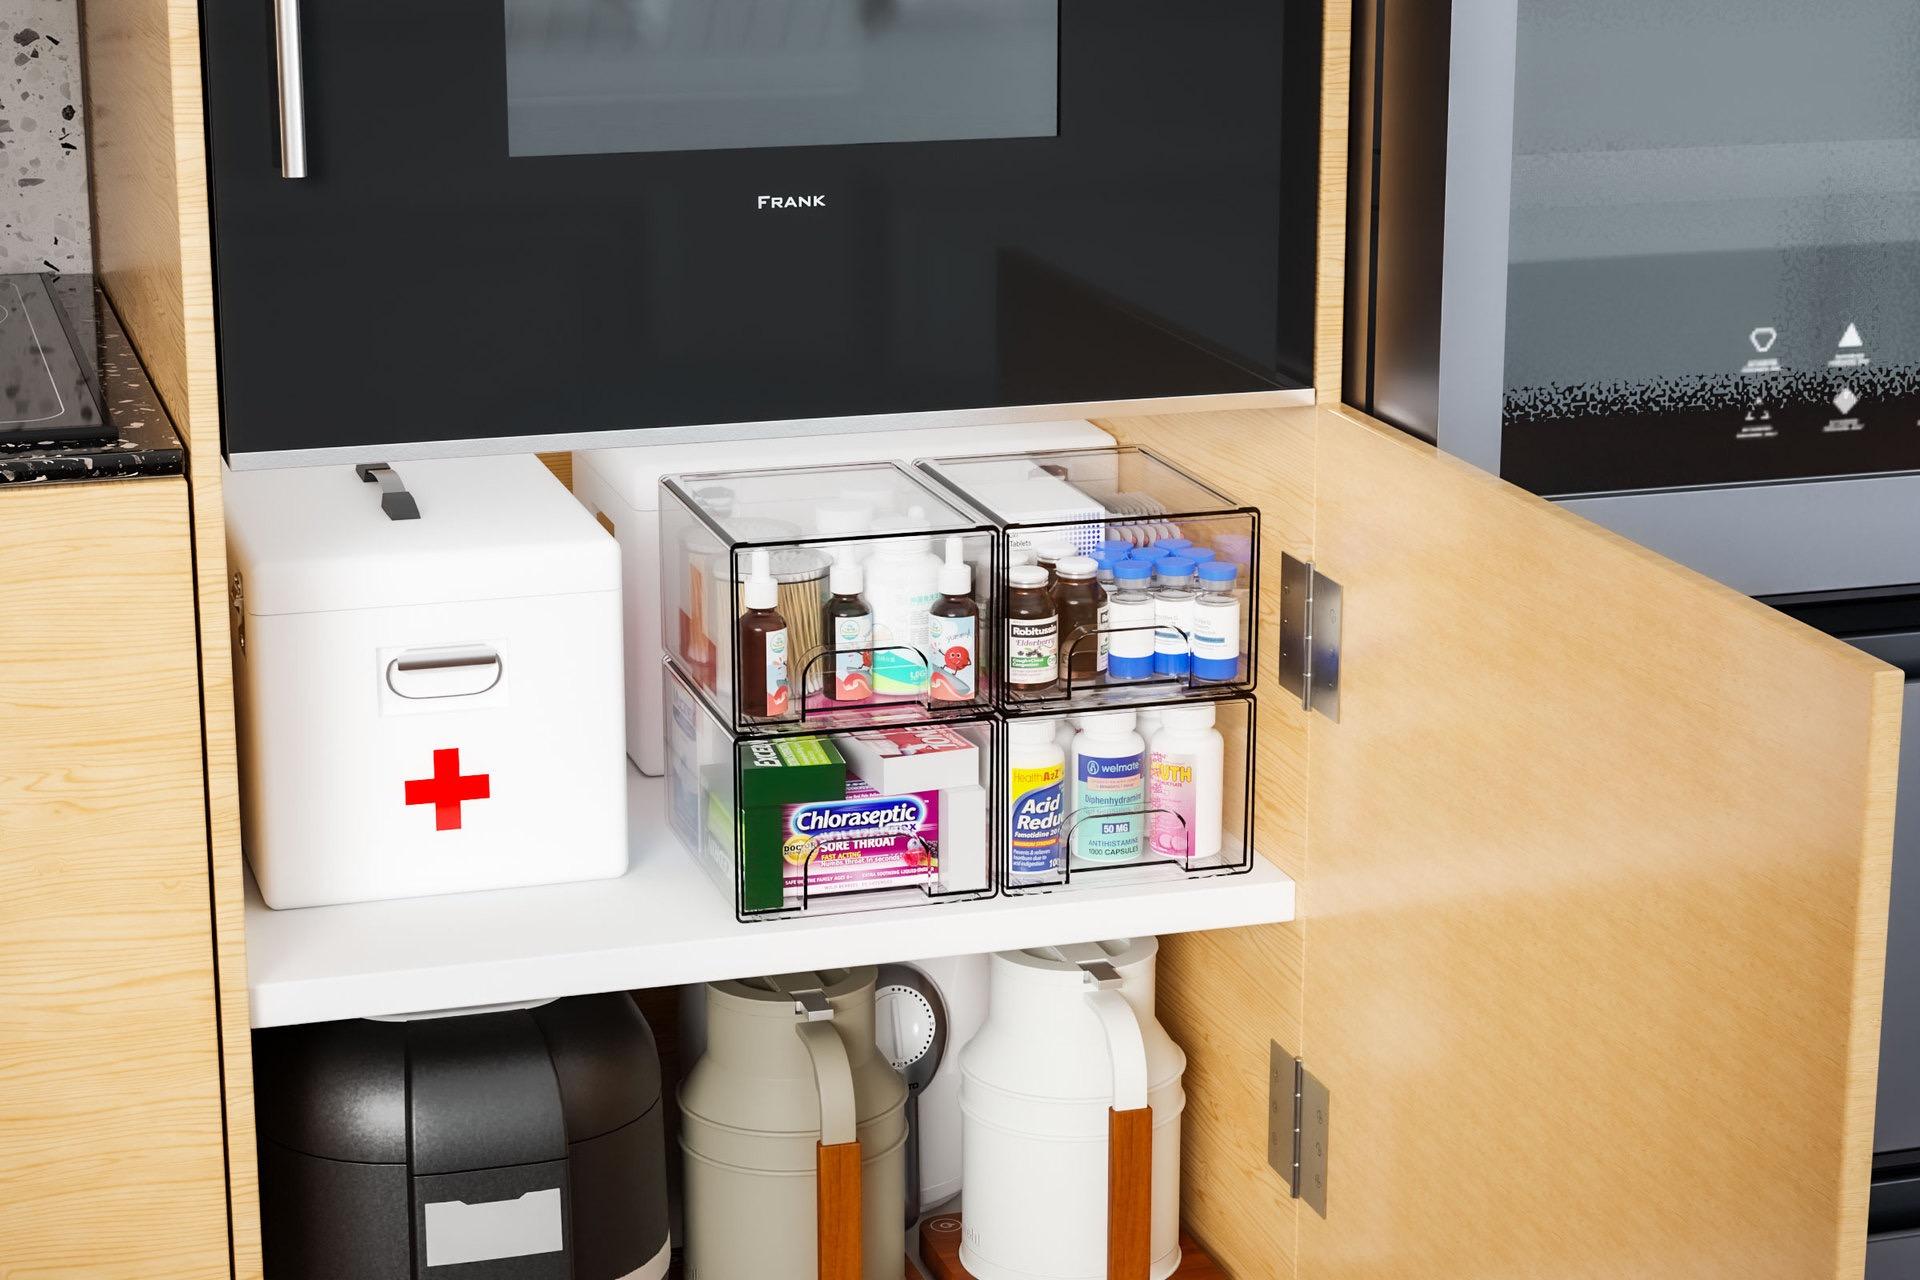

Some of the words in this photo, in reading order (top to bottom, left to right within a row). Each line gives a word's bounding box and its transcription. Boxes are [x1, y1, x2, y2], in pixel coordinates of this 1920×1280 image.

[757, 194, 826, 210] FRANK
[1101, 761, 1140, 772] welmate
[1021, 793, 1061, 814] Acid
[796, 803, 917, 831] Chloraseptic
[1103, 824, 1114, 834] 50
[1115, 823, 1129, 833] MG
[820, 838, 850, 852] SORE
[852, 836, 896, 850] THROAT
[820, 853, 837, 861] FAST
[837, 851, 861, 859] ACTING
